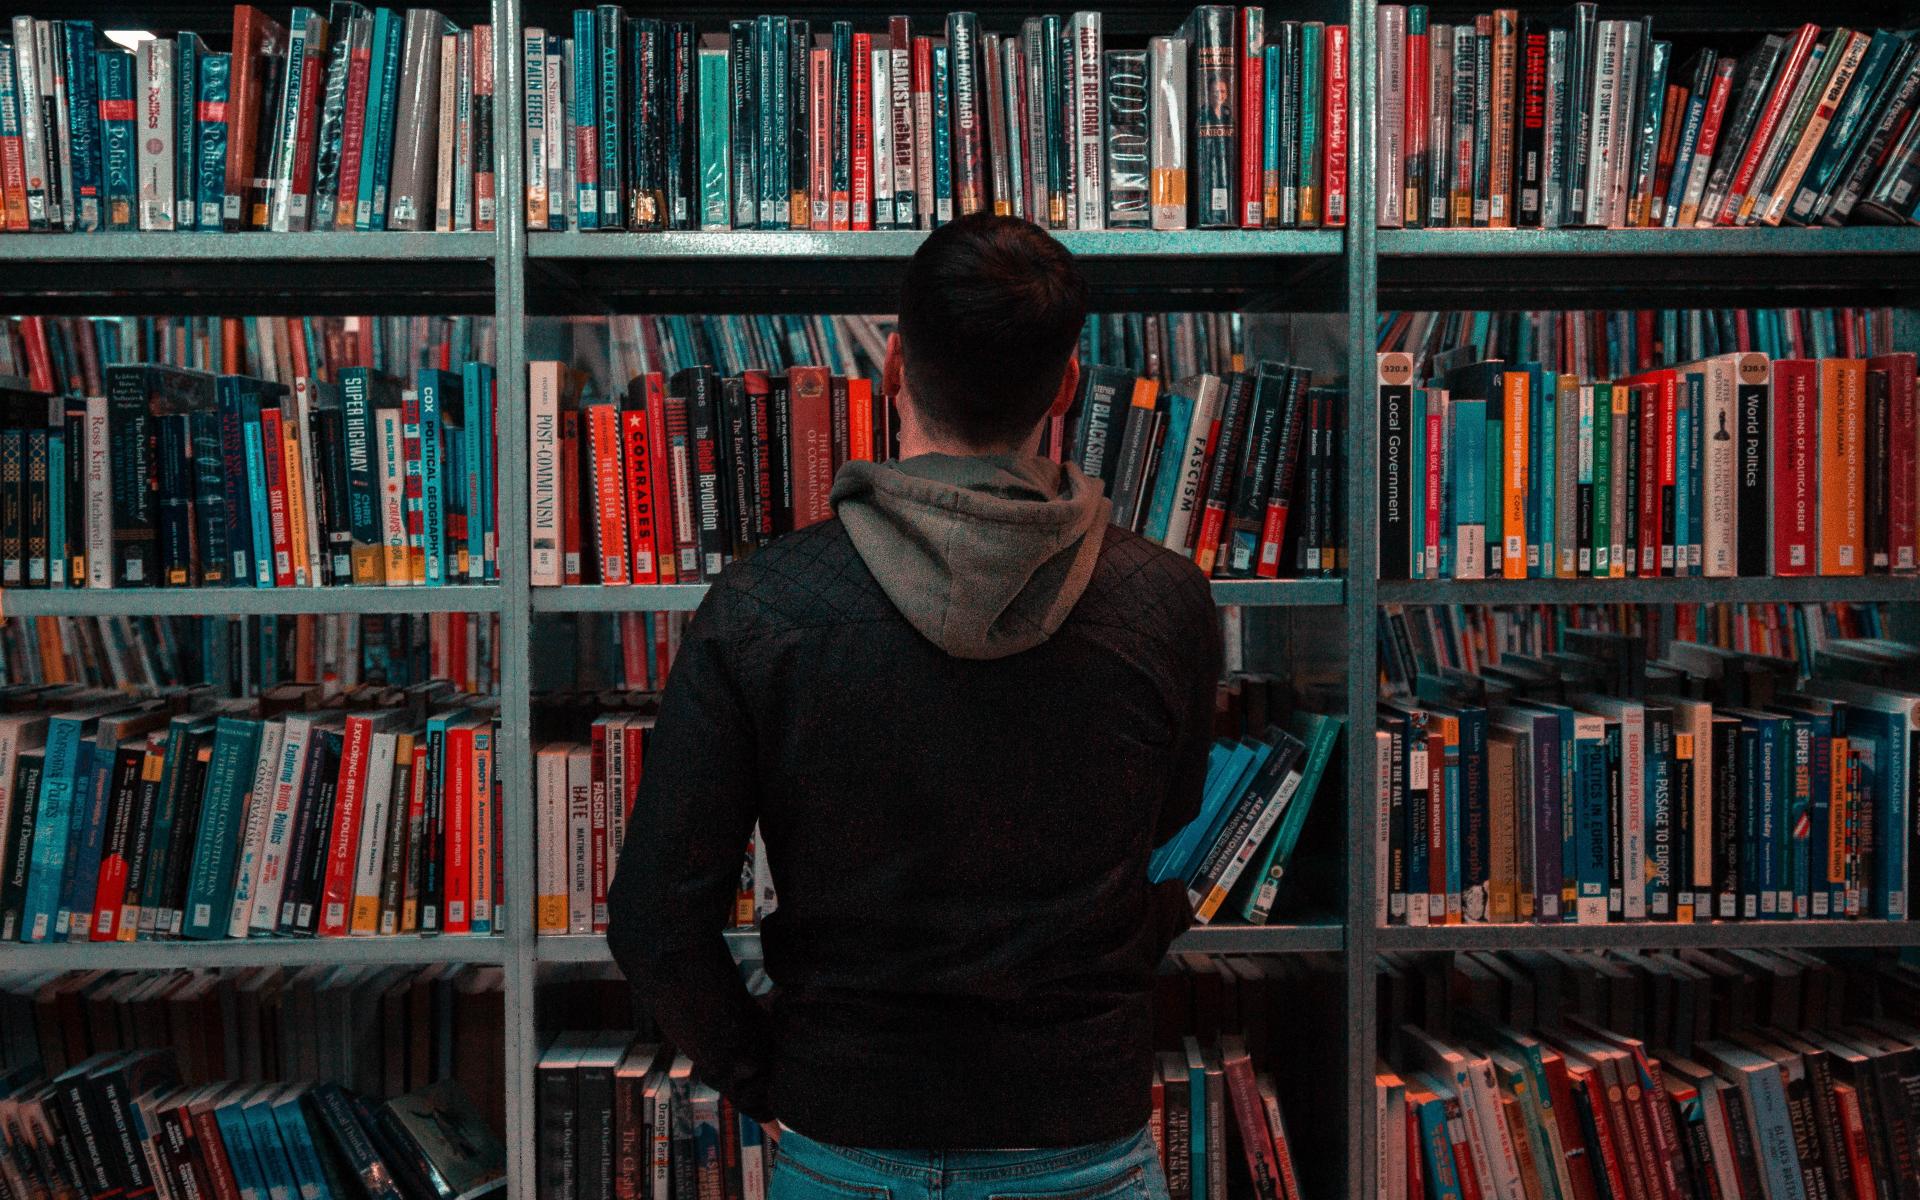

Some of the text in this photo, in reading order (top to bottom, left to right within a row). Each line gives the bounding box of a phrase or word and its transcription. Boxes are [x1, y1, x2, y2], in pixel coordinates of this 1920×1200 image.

[284, 40, 302, 140] POLITICAL RESEARCH
[527, 37, 543, 129] THE PALIN EFFECT
[549, 62, 558, 114] Leo Strauss
[604, 47, 616, 170] AMERICA ALONE
[893, 50, 910, 166] AGAINST THE GRAIN
[956, 24, 973, 128] JOAN MAYNARD
[1082, 64, 1097, 79] OF
[1082, 83, 1099, 136] REFORM
[1525, 34, 1546, 129] HOMELAND
[1599, 32, 1616, 147] THE ROAD TO SOMEWHERE
[0, 51, 23, 186] MICHAEL MOORE DOWNSIZE
[109, 58, 126, 186] Oxford Politics
[1553, 81, 1564, 184] SAVING THE PEOPLE
[1681, 102, 1702, 162] ANARCHISM
[92, 416, 104, 446] Ross
[344, 378, 367, 472] SUPER HIGHWAY
[697, 378, 706, 406] PONS
[733, 418, 743, 435] The
[89, 450, 105, 480] King
[136, 416, 148, 523] The Oxford Handbook of
[424, 386, 438, 557] COX POLITICAL GEOGRAPHY
[536, 415, 553, 528] POST-COMMUNISM
[633, 432, 650, 538] COMRADES
[696, 426, 718, 530] The Global Revolution
[734, 438, 744, 454] End
[756, 397, 772, 534] UNDER THE RED FLAG
[808, 430, 818, 520] OF COMMUNISM
[819, 434, 827, 453] THE
[820, 457, 828, 480] RISE
[1180, 438, 1206, 512] FASCISM
[1388, 396, 1401, 522] Local Government
[1746, 395, 1758, 487] World Politics
[1797, 437, 1804, 449] OF
[1797, 453, 1805, 498] POLITICAL
[271, 490, 286, 544] STATE BUILDING
[353, 493, 362, 527] PARRY
[362, 494, 371, 525] CHRIS
[602, 458, 616, 518] THE RED FLAG
[736, 467, 748, 515] Communist
[740, 517, 750, 542] Power
[820, 494, 830, 516] FALL
[271, 744, 299, 845] Exploring British Politics
[337, 723, 362, 858] EXPLORING BRITISH POLITICS
[593, 782, 605, 829] FASCISM
[1393, 733, 1402, 806] AFTER THE FALL
[1629, 734, 1639, 831] EUROPEAN POLITICS
[1763, 742, 1773, 838] European politics today
[1796, 729, 1809, 797] SUPER STATE
[1892, 726, 1900, 813] ARAB NATIONALISM
[12, 768, 39, 887] Patterns of Democracy
[206, 745, 238, 896] THE BRITISH CONSTITUTION
[573, 786, 588, 892] HATE MATTHEW COLLINS
[1590, 746, 1603, 869] POLITICS IN EUROPE
[1656, 761, 1669, 886] THE PASSAGE TO EUROPE
[105, 1085, 116, 1098] THE
[129, 1164, 142, 1186] RIGHT
[623, 1130, 635, 1190] The Clash
[657, 1104, 667, 1180] Orange Parades
[1170, 1112, 1178, 1127] OF
[1179, 1113, 1188, 1132] THE
[1170, 1157, 1179, 1189] ISLAM
